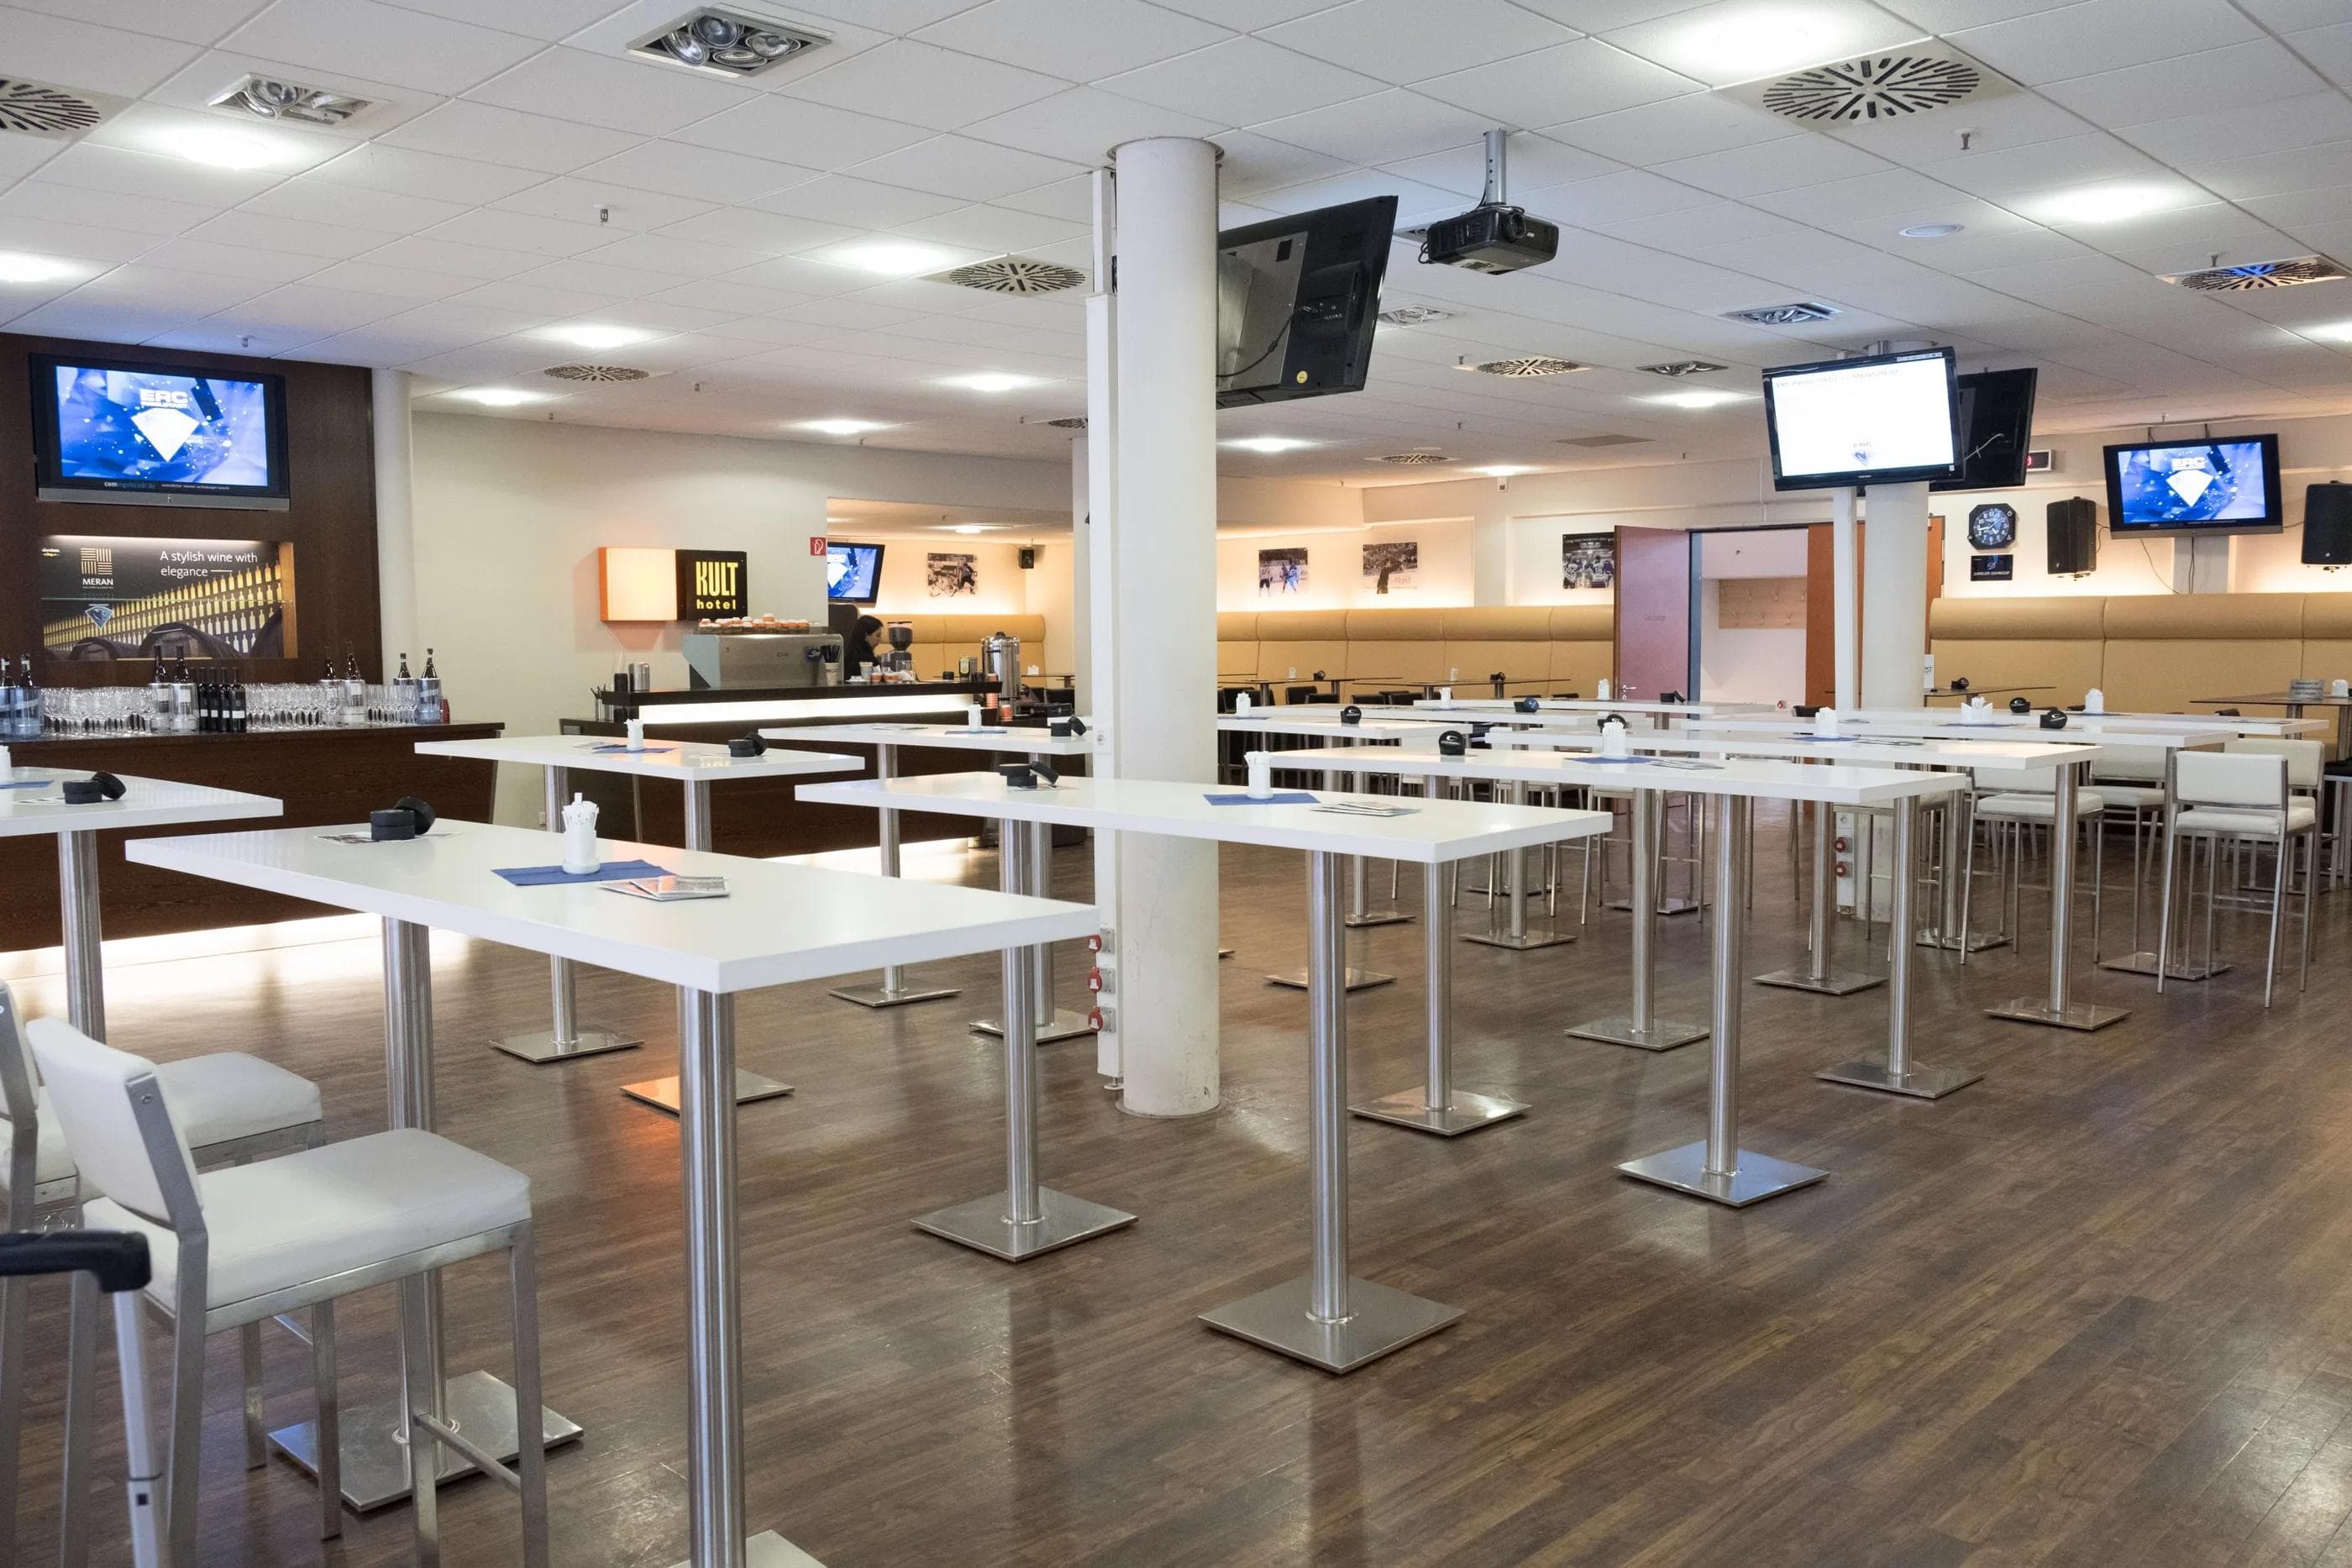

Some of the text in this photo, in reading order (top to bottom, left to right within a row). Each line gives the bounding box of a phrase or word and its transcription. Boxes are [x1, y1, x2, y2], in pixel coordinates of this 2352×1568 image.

[140, 389, 188, 402] ERC
[160, 551, 258, 564] A stylish wine with
[160, 566, 208, 579] elegance
[696, 561, 738, 596] KULT
[696, 599, 736, 610] hotel
